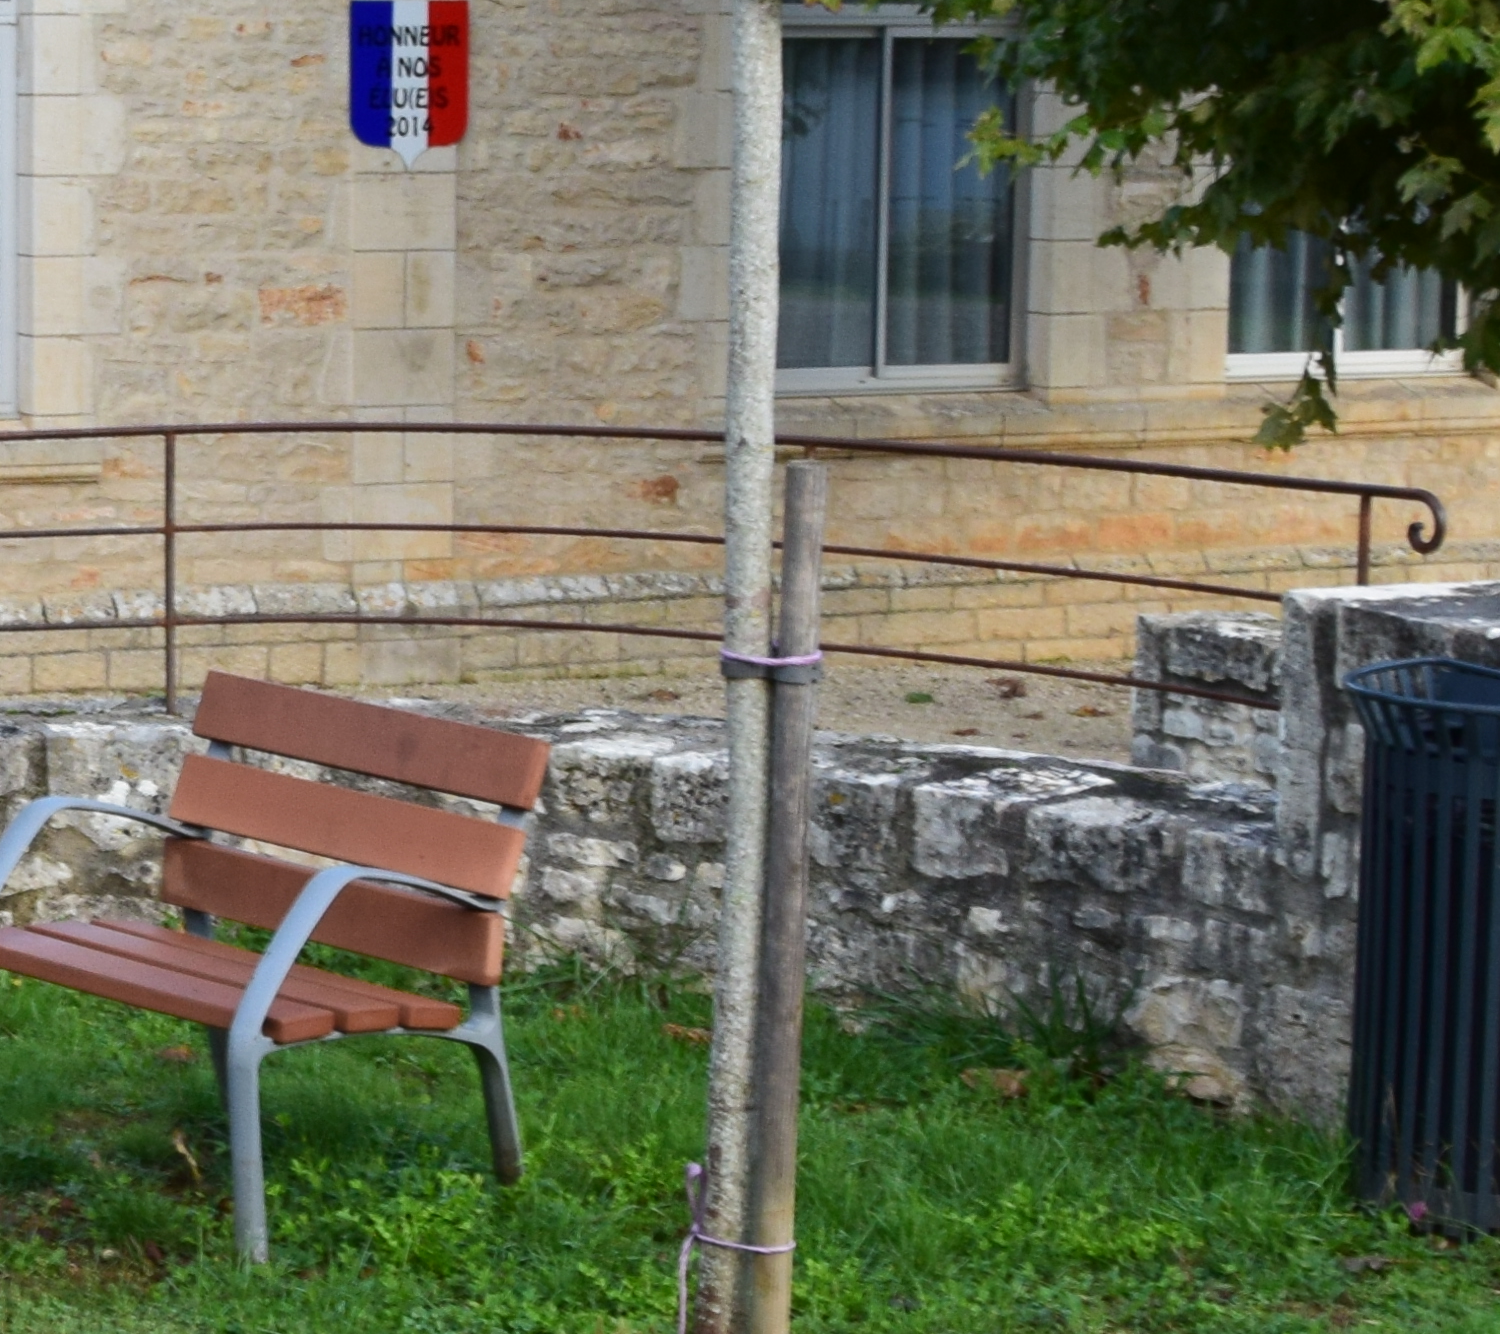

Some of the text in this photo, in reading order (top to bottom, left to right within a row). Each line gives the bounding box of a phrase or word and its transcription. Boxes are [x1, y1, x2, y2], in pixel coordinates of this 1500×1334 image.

[358, 25, 460, 47] HONNEUR
[398, 56, 441, 77] NOS
[386, 117, 434, 137] 2014
